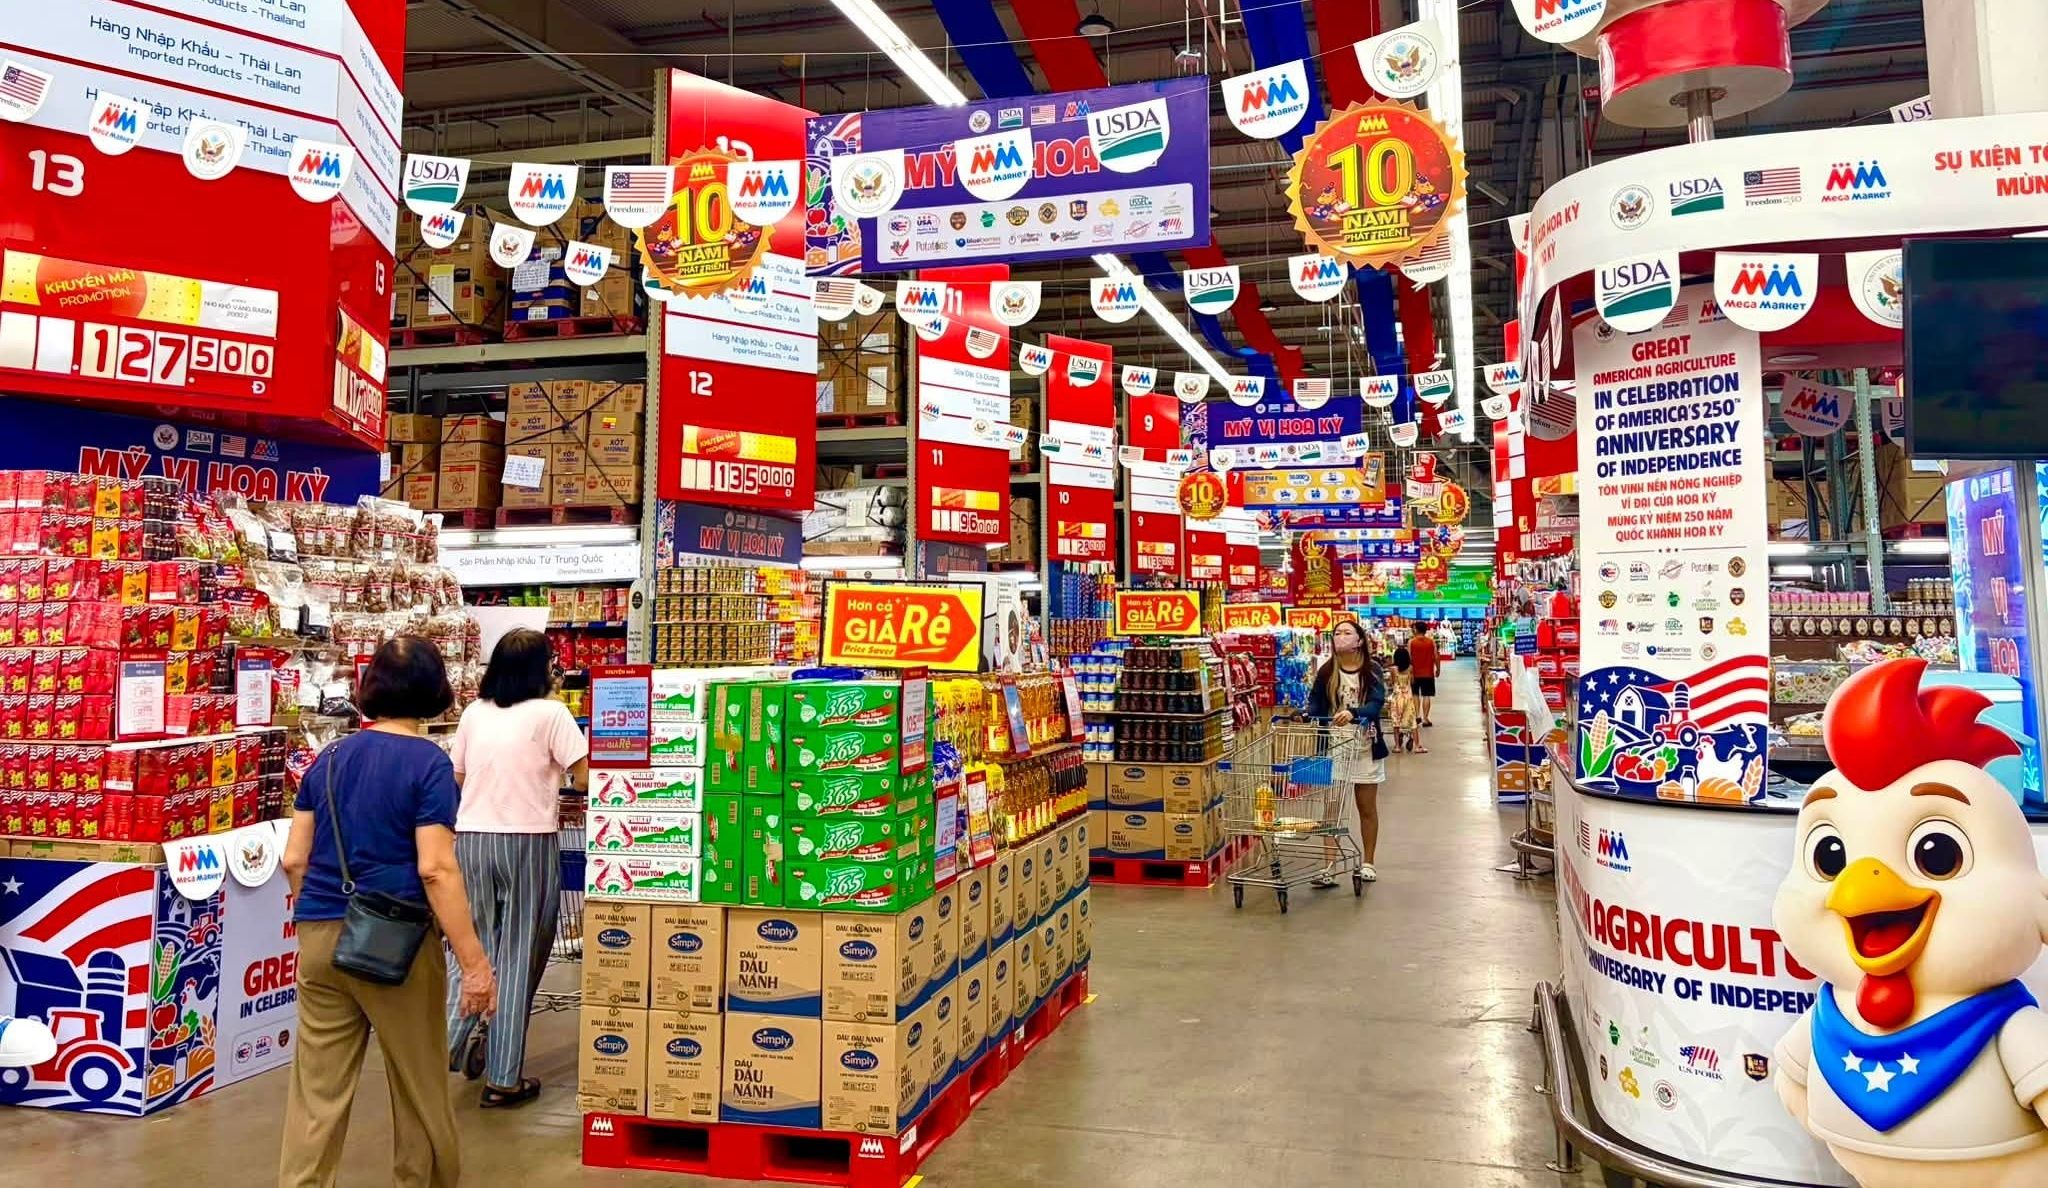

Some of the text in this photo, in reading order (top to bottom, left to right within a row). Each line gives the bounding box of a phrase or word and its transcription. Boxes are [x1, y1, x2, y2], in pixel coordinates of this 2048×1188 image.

[90, 15, 131, 41] Hàng
[135, 25, 176, 52] Nhập
[239, 52, 270, 72] Thái
[275, 61, 302, 79] Lan
[128, 43, 184, 67] Imported
[187, 57, 242, 81] Products
[999, 108, 1023, 118] USDA
[1096, 107, 1160, 137] USDA
[1970, 144, 2021, 171] KIỆN
[28, 148, 86, 197] 13
[411, 160, 460, 182] USDA
[1327, 138, 1414, 208] 10
[1670, 177, 1724, 200] USDA
[671, 184, 732, 243] 10
[1188, 271, 1233, 287] USDA
[1601, 257, 1671, 292] USDA
[59, 285, 131, 308] PROMOTION
[946, 287, 963, 317] 11
[1631, 334, 1691, 362] GREAT
[1071, 358, 1098, 371] USDA
[1593, 353, 1736, 386] AMERICAN AGRICULTURE
[688, 370, 714, 397] 12
[1417, 373, 1449, 386] USDA
[1594, 372, 1740, 410] IN CELEBRATION
[1143, 414, 1154, 432] 9
[1223, 413, 1345, 440] MỸ VỊ HOA KỲ
[1595, 414, 1615, 432] OF
[1618, 403, 1700, 430] AMERICA'S
[1596, 420, 1740, 457] ANNIVERSARY
[931, 448, 943, 467] 11
[1596, 449, 1742, 478] OF INDEPENDENCE
[206, 461, 278, 501] HOA
[286, 466, 330, 502] KỲ
[1233, 472, 1240, 484] 7
[1058, 491, 1070, 505] 10
[1187, 482, 1216, 500] 10
[1598, 481, 1619, 497] TÔN
[1620, 480, 1645, 494] VINH
[1676, 493, 1700, 506] HOA
[1137, 515, 1144, 527] 9
[1684, 509, 1705, 522] 250
[699, 524, 725, 550] MỸ
[742, 532, 766, 556] HOA
[767, 532, 785, 557] KỲ
[1684, 526, 1707, 539] HOA
[555, 555, 580, 567] Trung
[1270, 576, 1287, 589] 50
[1127, 599, 1185, 624] GIÁ Rẻ
[845, 601, 953, 647] GIÁ Rẻ
[844, 645, 895, 657] Price Saver
[760, 922, 795, 938] Simply
[671, 935, 700, 949] Simply
[842, 943, 876, 957] Simply
[1674, 976, 1703, 1001] OF
[240, 999, 254, 1019] IN
[597, 1037, 626, 1051] Simply
[669, 1041, 699, 1055] Simply
[755, 1031, 791, 1047] Simply
[844, 1052, 876, 1067] Simply
[1695, 1068, 1724, 1081] PORK
